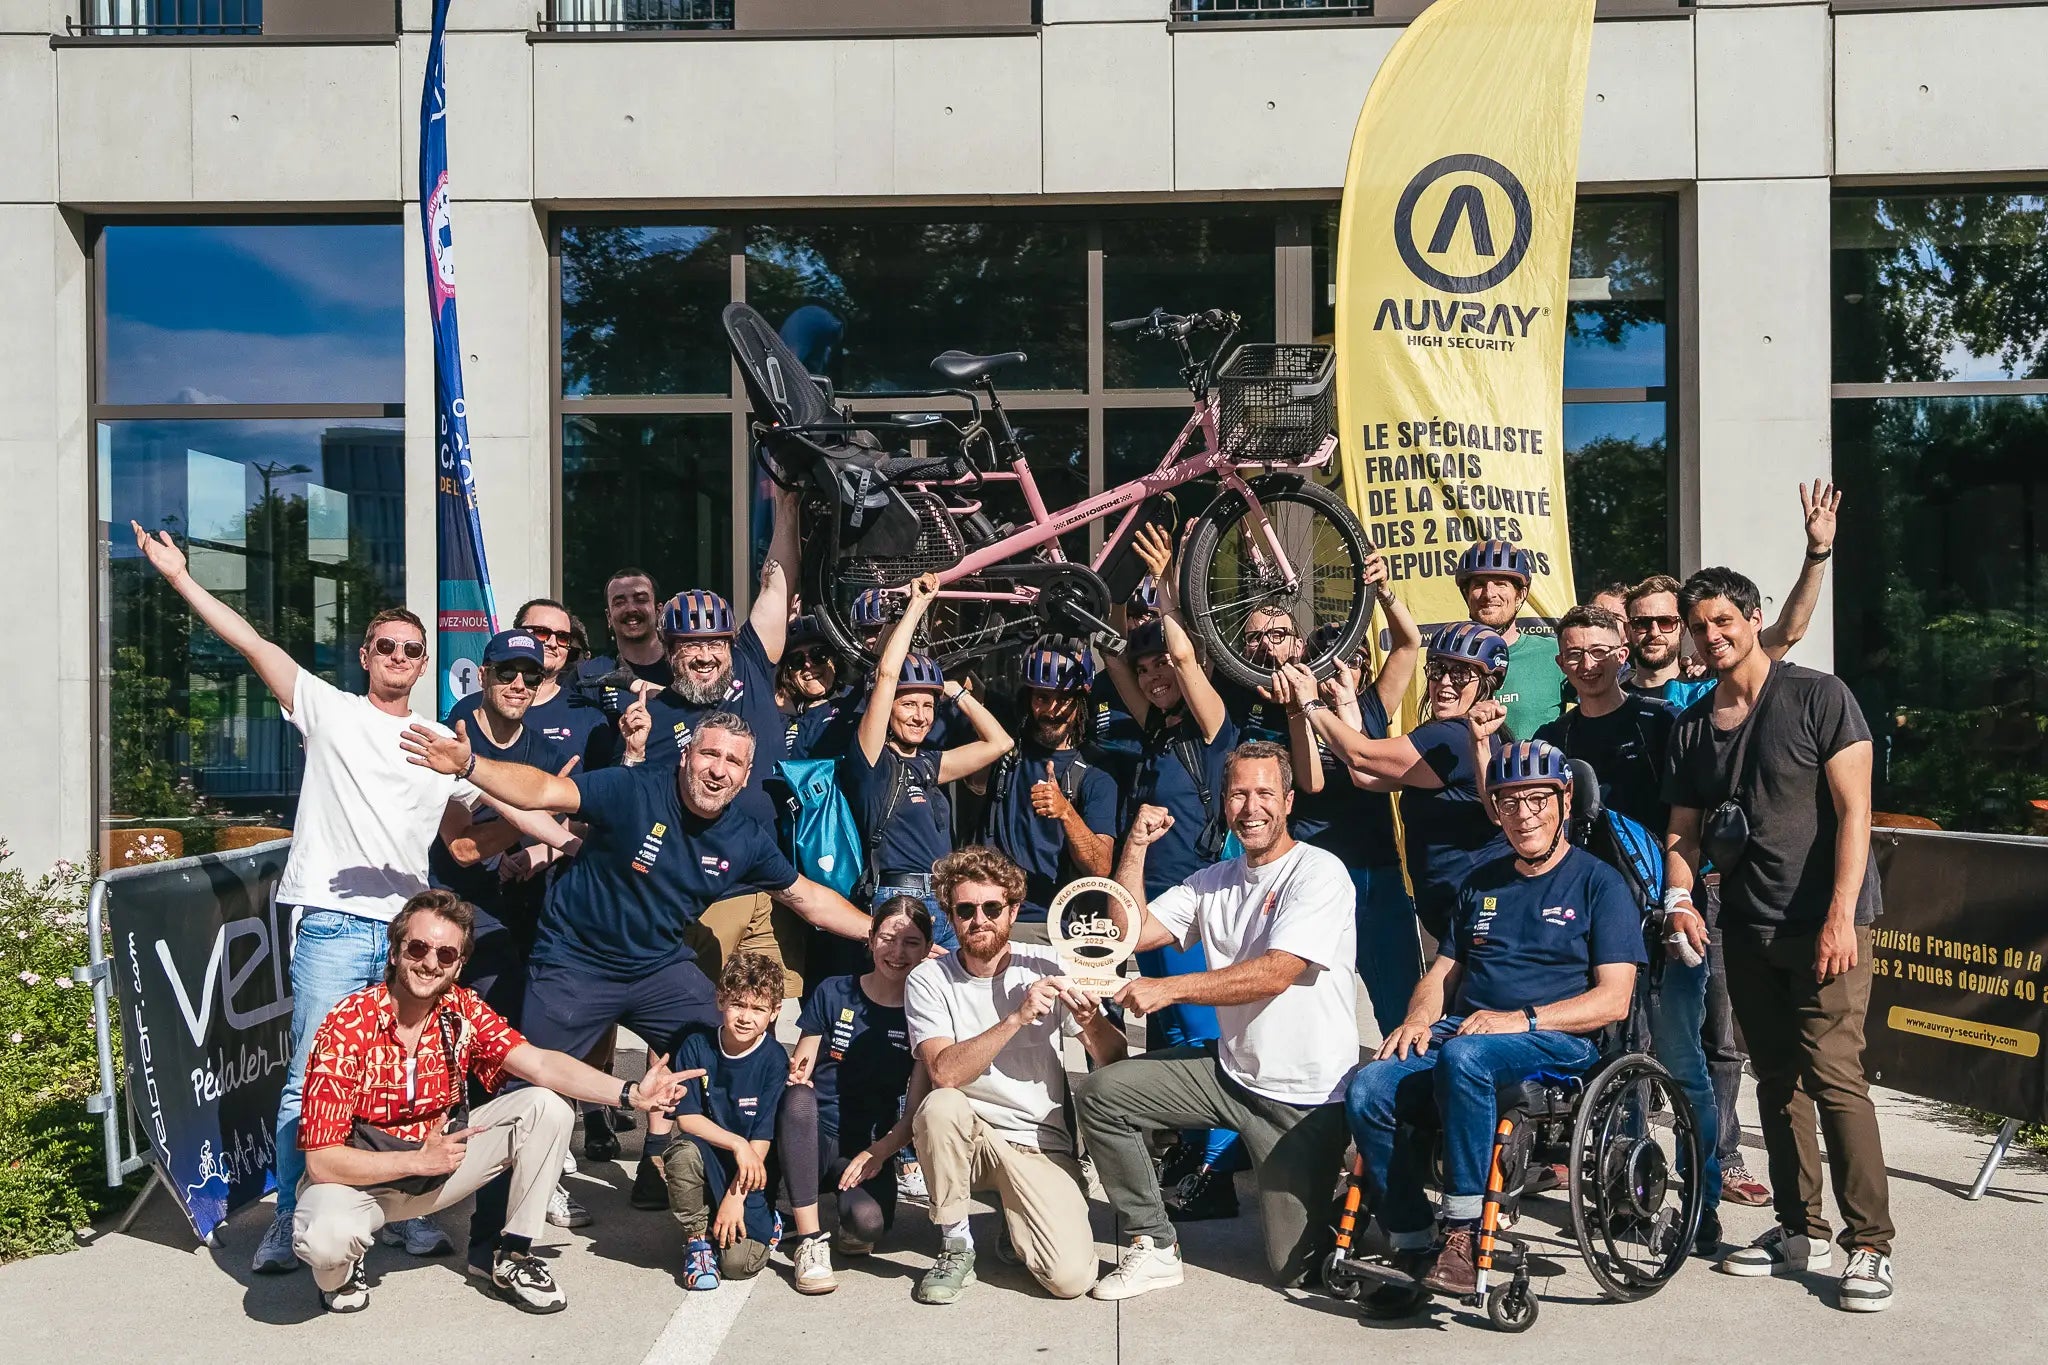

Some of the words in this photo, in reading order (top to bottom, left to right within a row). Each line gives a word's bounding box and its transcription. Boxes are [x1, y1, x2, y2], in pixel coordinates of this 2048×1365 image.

[1407, 335, 1442, 347] HIGH
[1447, 337, 1515, 351] SECURITY
[1363, 423, 1389, 450] LE
[1397, 416, 1542, 454] SPÉCIALISTE
[1366, 453, 1482, 484] FRANÇAIS
[1368, 488, 1397, 516] DE
[1405, 486, 1433, 512] LA
[1441, 480, 1550, 516] SÉCURITÉ
[1372, 520, 1415, 549] DES
[1423, 519, 1438, 544] 2
[1446, 516, 1523, 542] ROUES
[1072, 882, 1097, 892] CARGO
[1085, 937, 1104, 945] 2025
[1870, 928, 1920, 953] cialiste
[1927, 935, 1998, 964] Français
[2004, 947, 2023, 968] de
[2027, 951, 2042, 972] la
[1074, 958, 1114, 968] VAINQUEUR
[1872, 957, 1888, 976] es
[1894, 959, 1903, 979] 2
[1908, 963, 1953, 987] roues
[1959, 970, 2009, 997] depuis
[2014, 979, 2035, 1001] 40
[1906, 1017, 2018, 1047] www.auvray-security.com
[191, 1043, 275, 1107] Pédaler
